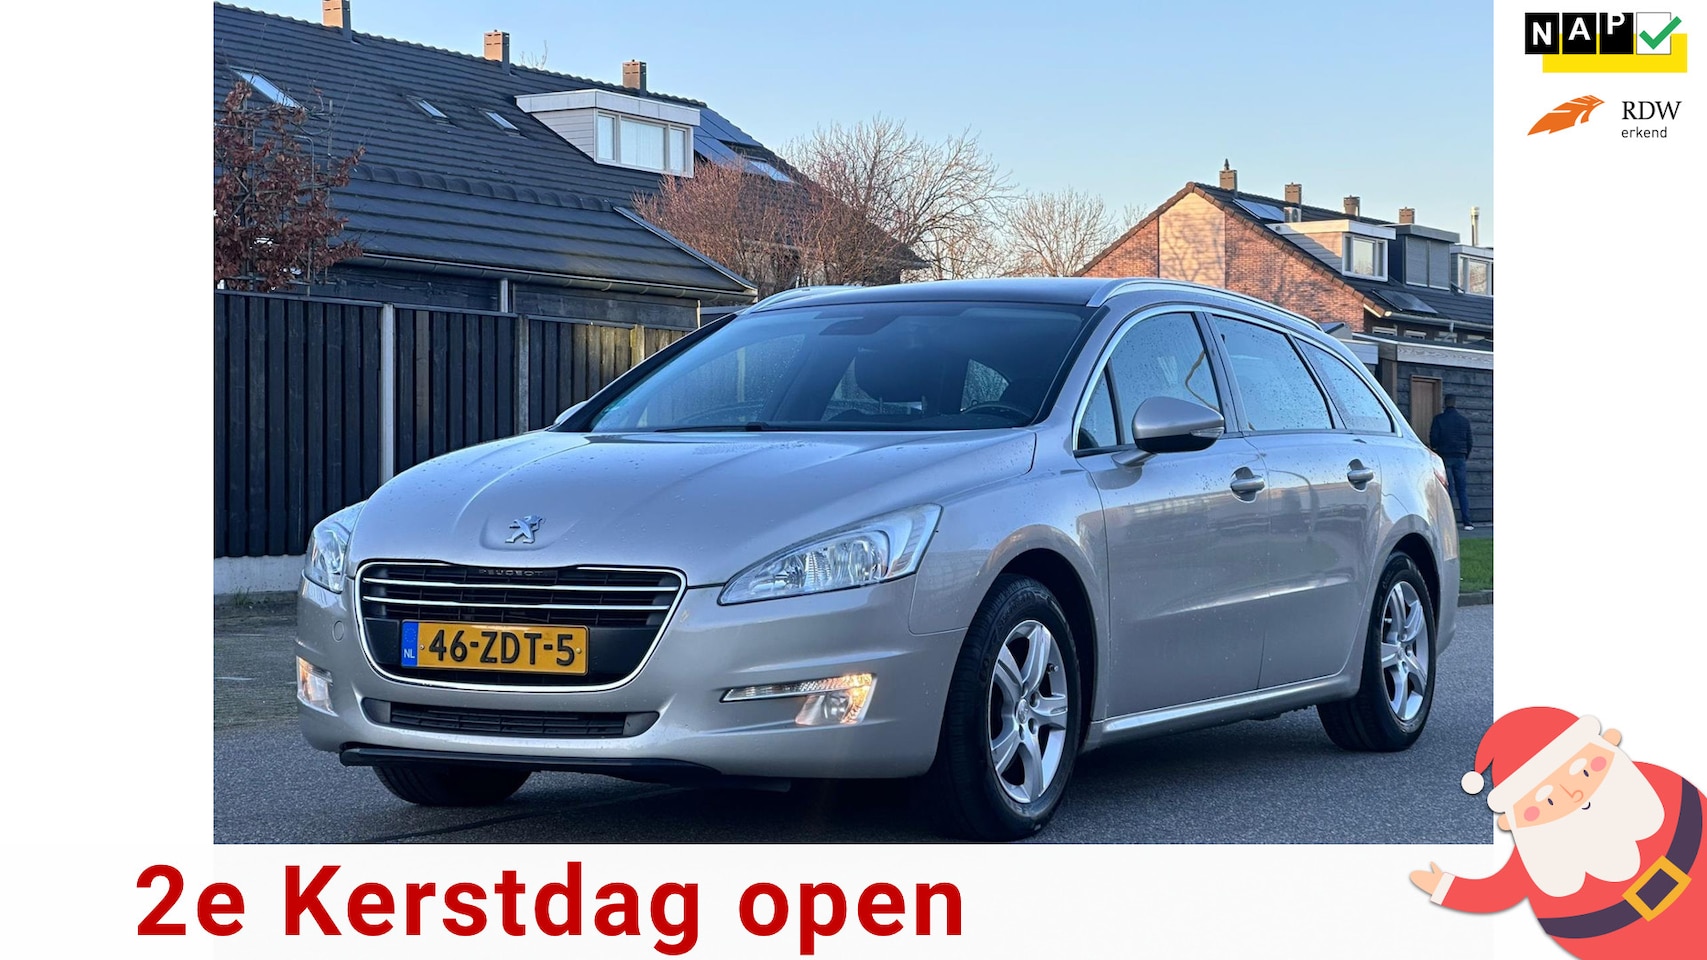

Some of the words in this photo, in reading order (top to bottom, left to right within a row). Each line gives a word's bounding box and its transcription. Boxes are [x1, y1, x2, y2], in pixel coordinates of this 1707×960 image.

[478, 568, 544, 577] PEUGEOT
[403, 648, 416, 660] NL
[428, 629, 576, 667] 46-ZDT-5
